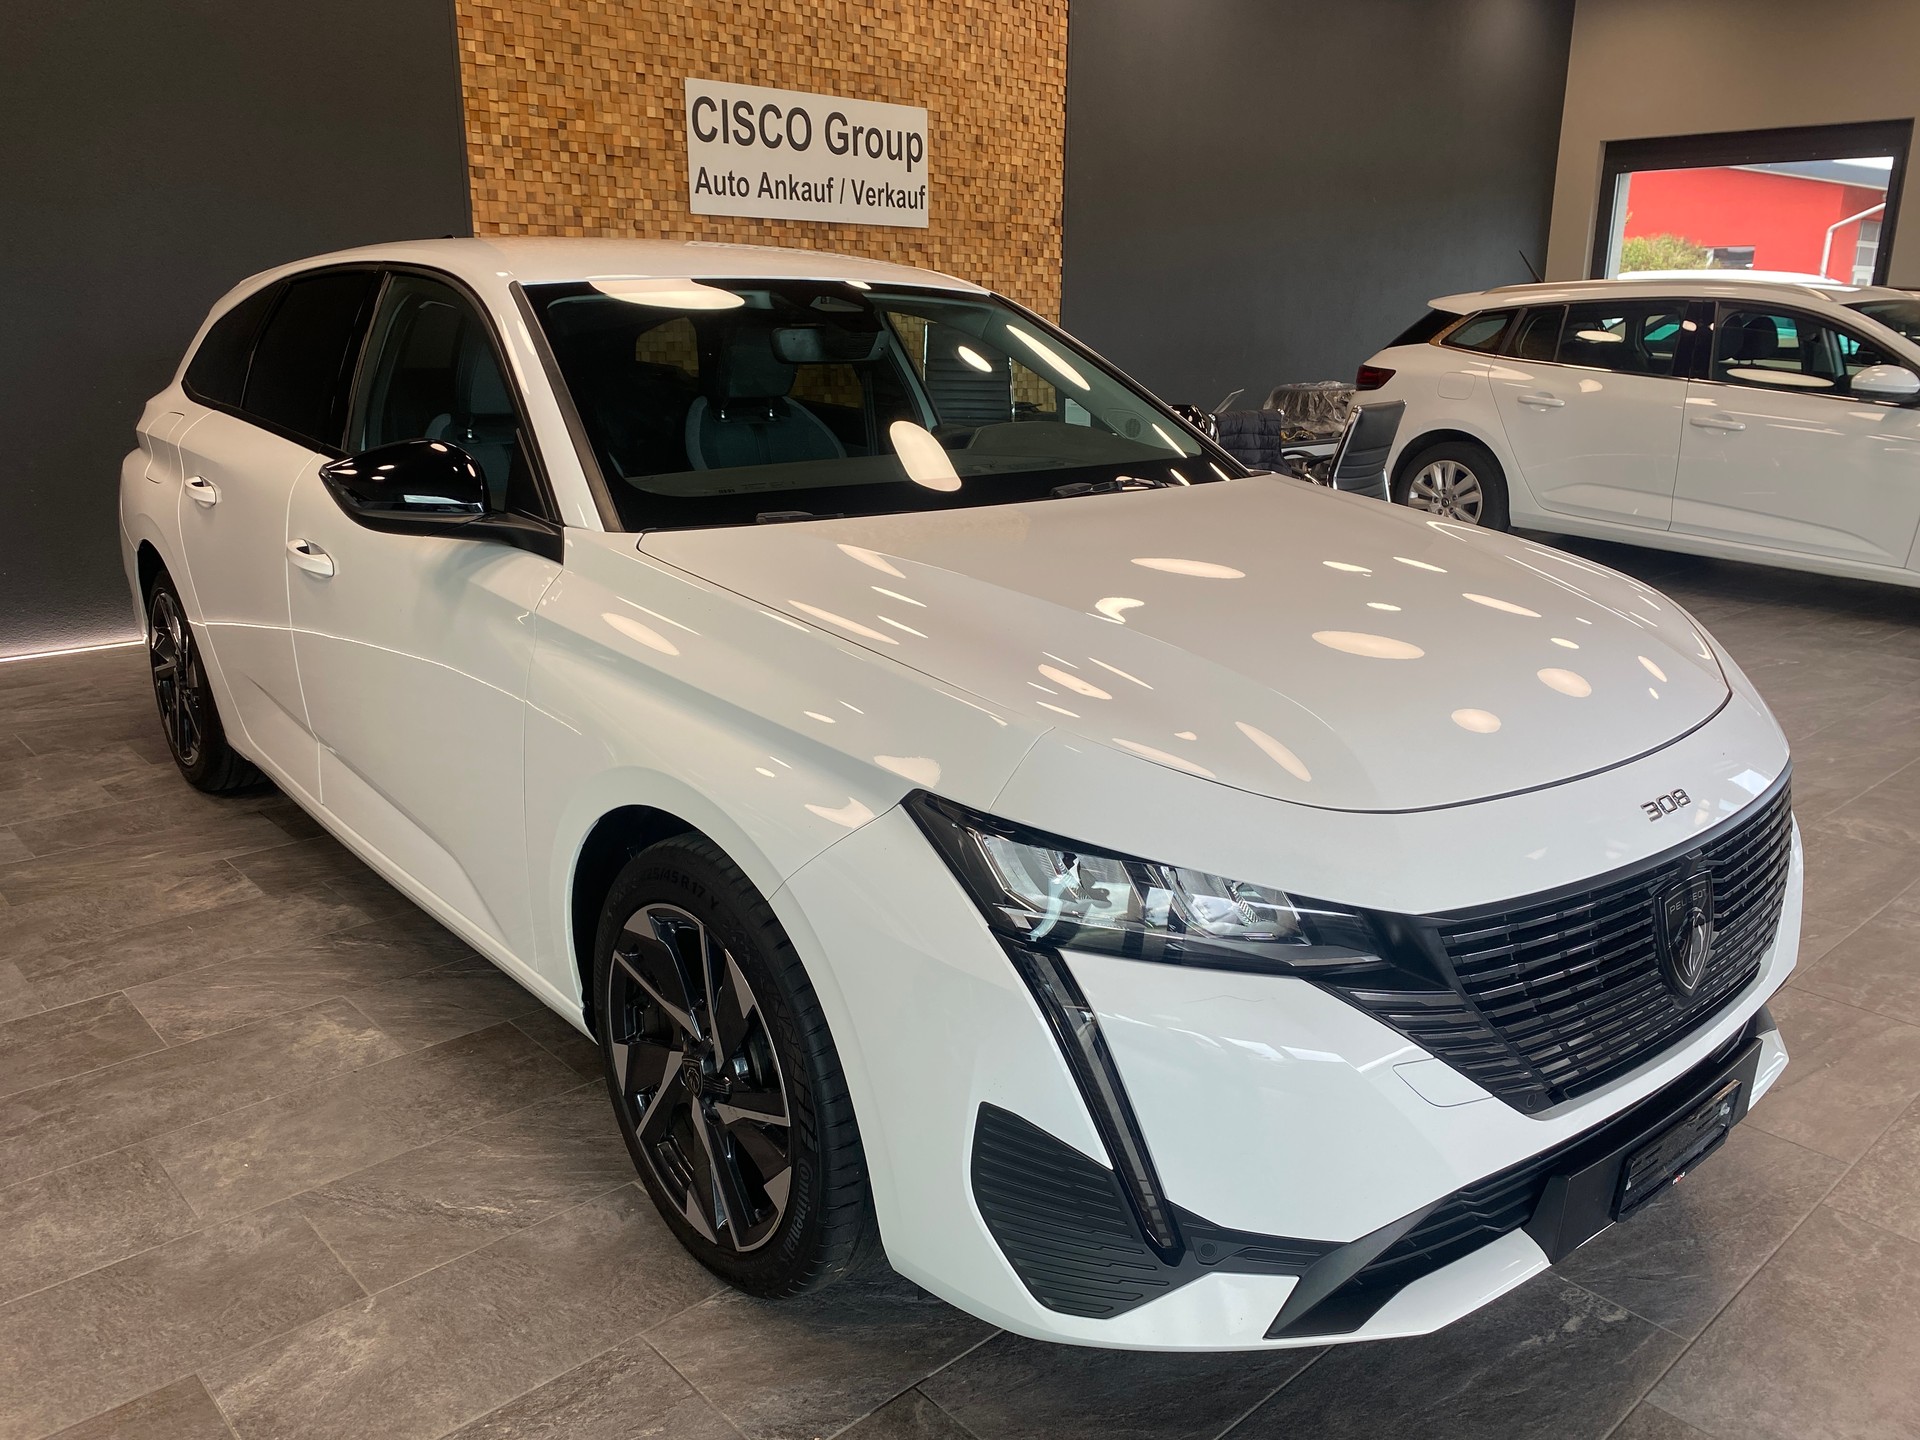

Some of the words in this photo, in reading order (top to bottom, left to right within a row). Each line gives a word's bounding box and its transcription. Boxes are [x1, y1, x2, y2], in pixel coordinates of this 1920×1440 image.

[691, 95, 812, 152] CISCO
[824, 111, 924, 173] Group
[694, 166, 750, 198] Auto
[757, 171, 834, 204] Ankauf
[839, 178, 846, 204] /
[850, 178, 926, 210] Verkauf
[1640, 788, 1692, 822] 308
[1669, 888, 1707, 915] PEUGEOT
[782, 1156, 814, 1259] Continental
